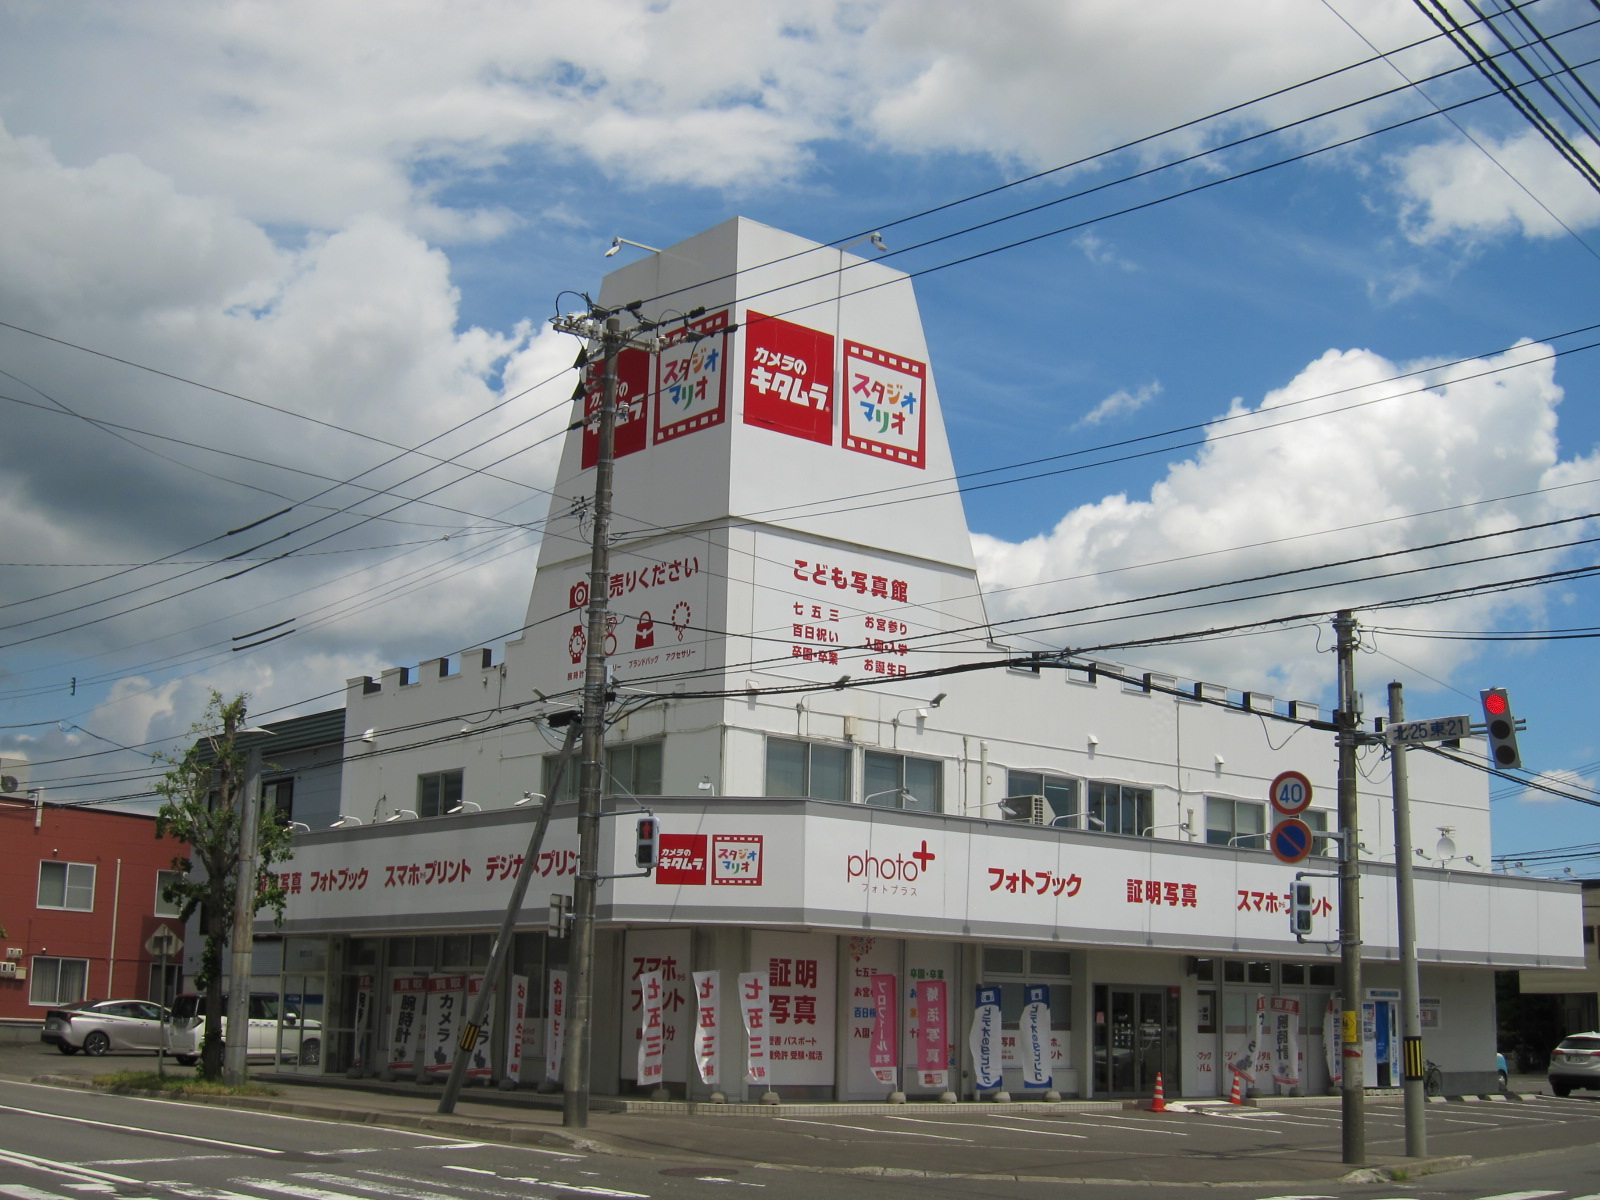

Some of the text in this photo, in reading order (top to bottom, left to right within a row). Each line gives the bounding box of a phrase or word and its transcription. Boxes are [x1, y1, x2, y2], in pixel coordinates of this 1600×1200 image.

[663, 347, 719, 385] スタジオ
[753, 346, 807, 377] カメラの
[669, 375, 708, 411] マリオ
[749, 365, 830, 412] キタムラ
[851, 373, 917, 415] スタジオ
[858, 400, 905, 436] マリオ
[793, 559, 908, 603] こども写真館
[793, 601, 840, 622] 七五三
[792, 623, 839, 642] 百日祝い
[864, 616, 908, 635] お宮参り
[864, 658, 907, 678] お誕生日
[1279, 783, 1302, 804] 40
[659, 857, 703, 871] キタムラ
[661, 848, 691, 858] カメラの
[717, 848, 758, 862] スタジオ
[310, 867, 369, 892] フォトブック
[722, 860, 751, 875] マリオ
[861, 882, 918, 897] フォトプラス
[988, 867, 1082, 898] フォトブック
[1126, 878, 1198, 909] 証明写真
[436, 978, 461, 990] 買取
[769, 958, 818, 989] 証明
[395, 994, 416, 1044] 腕時計
[437, 994, 454, 1043] カメラ
[769, 994, 817, 1026] 写真
[784, 1036, 817, 1046] パスポート
